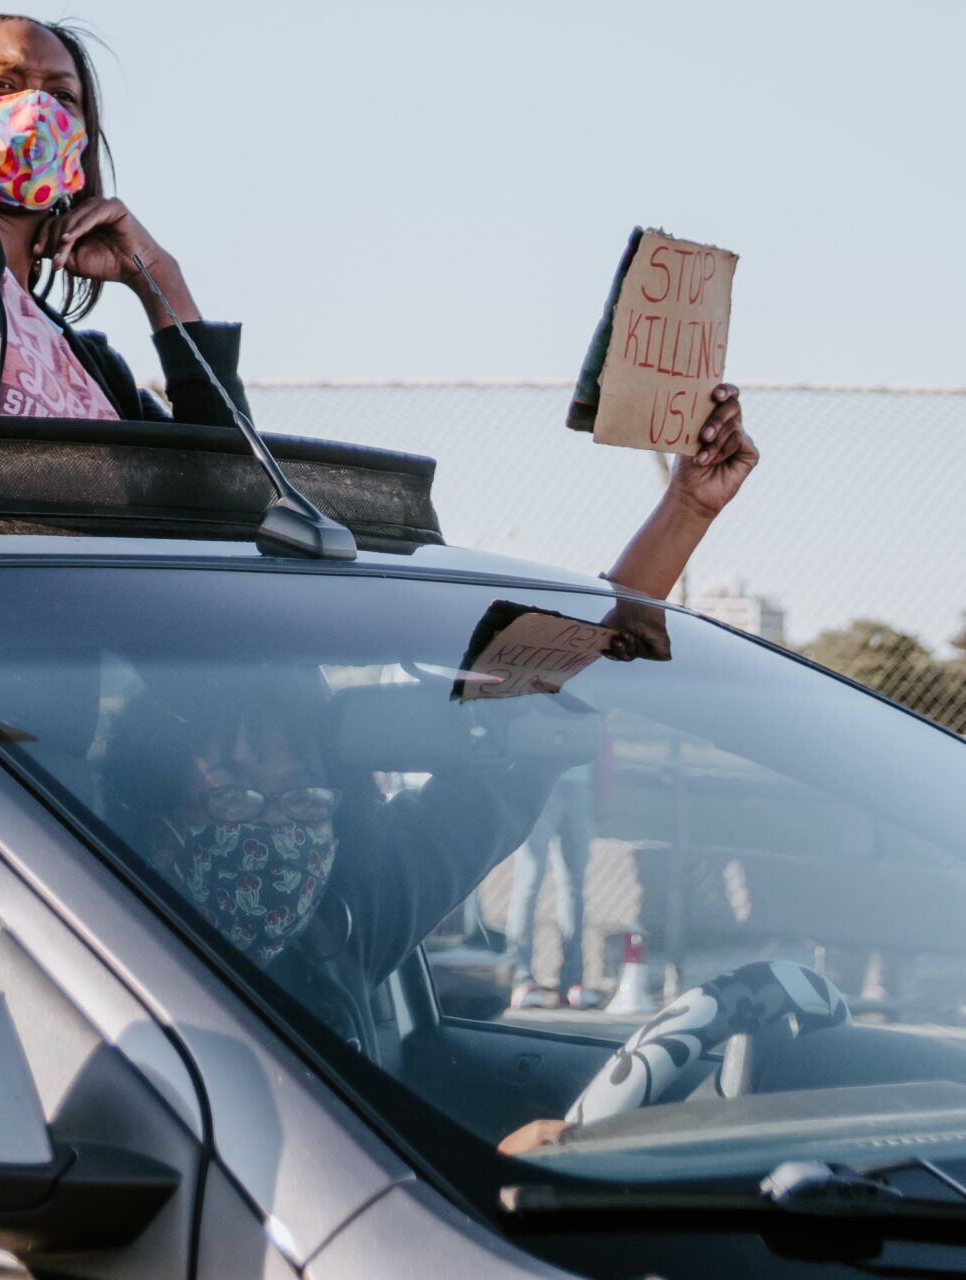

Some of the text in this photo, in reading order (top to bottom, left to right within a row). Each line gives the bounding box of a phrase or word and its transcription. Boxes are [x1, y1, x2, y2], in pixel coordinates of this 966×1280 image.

[640, 245, 717, 305] STOP
[623, 308, 725, 380] KILLING
[649, 387, 699, 446] US!
